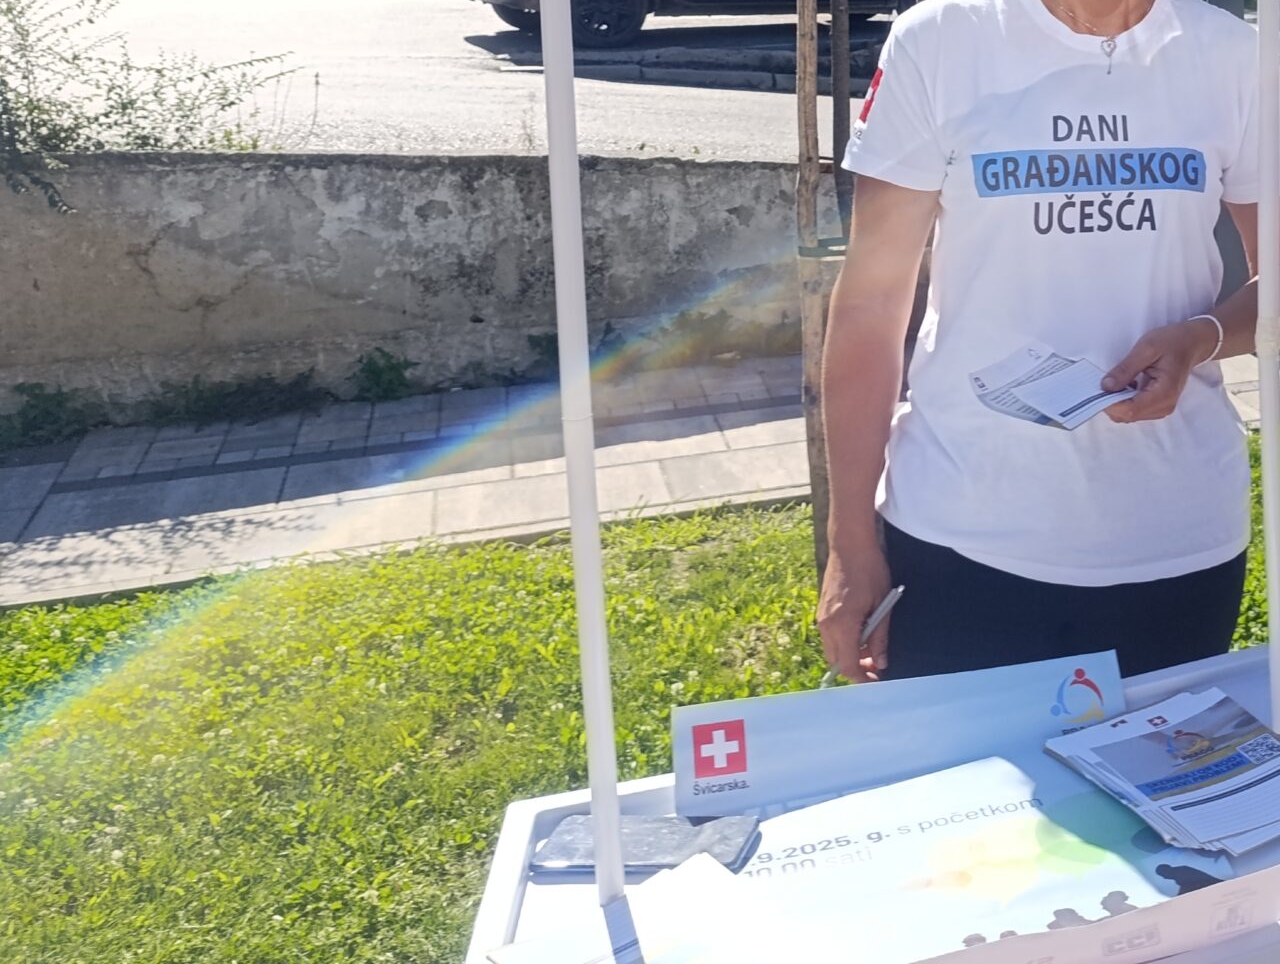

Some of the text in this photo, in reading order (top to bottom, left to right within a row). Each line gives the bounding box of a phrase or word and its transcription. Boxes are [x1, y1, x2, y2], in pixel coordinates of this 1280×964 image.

[1052, 114, 1129, 142] DANI
[981, 152, 1199, 192] GRAĐANSKOG
[1034, 192, 1157, 235] UČEŠĆA
[751, 797, 1044, 866] .9.2025. g. s početkom
[825, 846, 873, 865] sati
